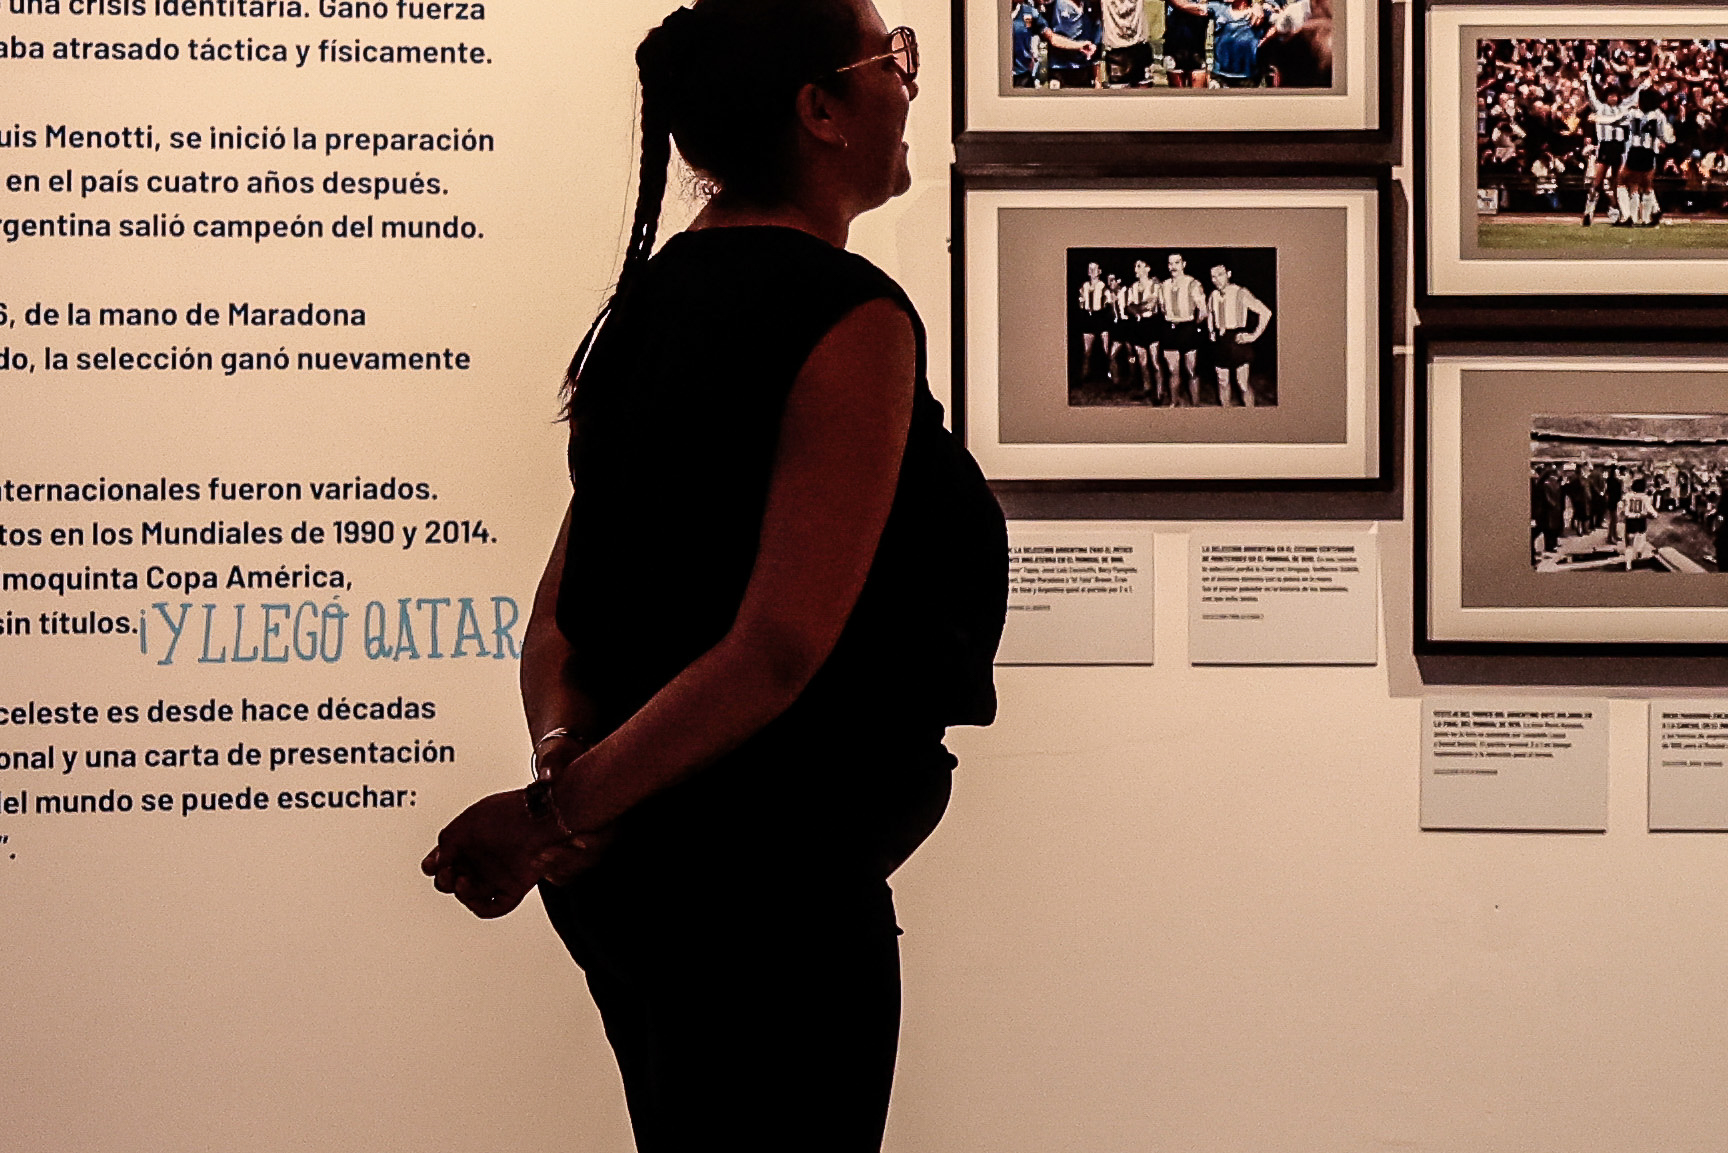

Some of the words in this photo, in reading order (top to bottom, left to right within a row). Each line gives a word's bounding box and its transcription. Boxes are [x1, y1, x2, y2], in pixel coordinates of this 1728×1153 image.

[52, 37, 180, 61] atrasado
[187, 37, 288, 62] táctica
[295, 44, 311, 68] y
[317, 38, 492, 65] físicamente.
[45, 124, 161, 153] Menotti,
[169, 131, 202, 150] se
[209, 125, 286, 150] inició
[293, 126, 317, 151] la
[325, 127, 494, 157] preparación
[5, 174, 40, 193] en
[48, 168, 72, 193] el
[80, 169, 139, 199] país
[146, 170, 239, 194] cuatro
[246, 170, 315, 194] años
[322, 170, 449, 201] después.
[119, 212, 185, 238] salió
[193, 214, 324, 244] campeón
[331, 214, 373, 239] del
[381, 215, 484, 240] mundo.
[24, 301, 60, 327] de
[67, 302, 91, 327] la
[99, 307, 178, 327] mano
[185, 302, 220, 327] de
[228, 302, 366, 327] Maradona
[44, 346, 69, 371] la
[76, 345, 213, 371] selección
[220, 345, 290, 377] ganó
[297, 347, 471, 371] nuevamente
[0, 476, 201, 503] ternacionales
[207, 477, 302, 501] fueron
[309, 475, 438, 501] variados.
[50, 527, 84, 547] en
[92, 521, 134, 546] los
[141, 520, 283, 546] Mundiales
[290, 520, 325, 545] de
[332, 520, 395, 545] 1990
[402, 525, 418, 550] y
[424, 519, 497, 545] 2014.
[2, 565, 138, 597] moquinta
[146, 565, 218, 592] Copa
[227, 563, 354, 591] América,
[38, 610, 138, 636] títulos.
[363, 595, 524, 663] QATAR
[106, 705, 140, 724] es
[147, 698, 234, 723] desde
[241, 697, 309, 723] hace
[317, 695, 436, 721] décadas
[62, 750, 79, 776] y
[85, 749, 137, 769] una
[144, 744, 219, 768] carta
[227, 741, 262, 766] de
[269, 739, 455, 772] presentación
[0, 789, 27, 815] el
[35, 788, 133, 815] mundo
[140, 793, 174, 812] se
[181, 786, 270, 818] puede
[277, 784, 417, 810] escuchar:
